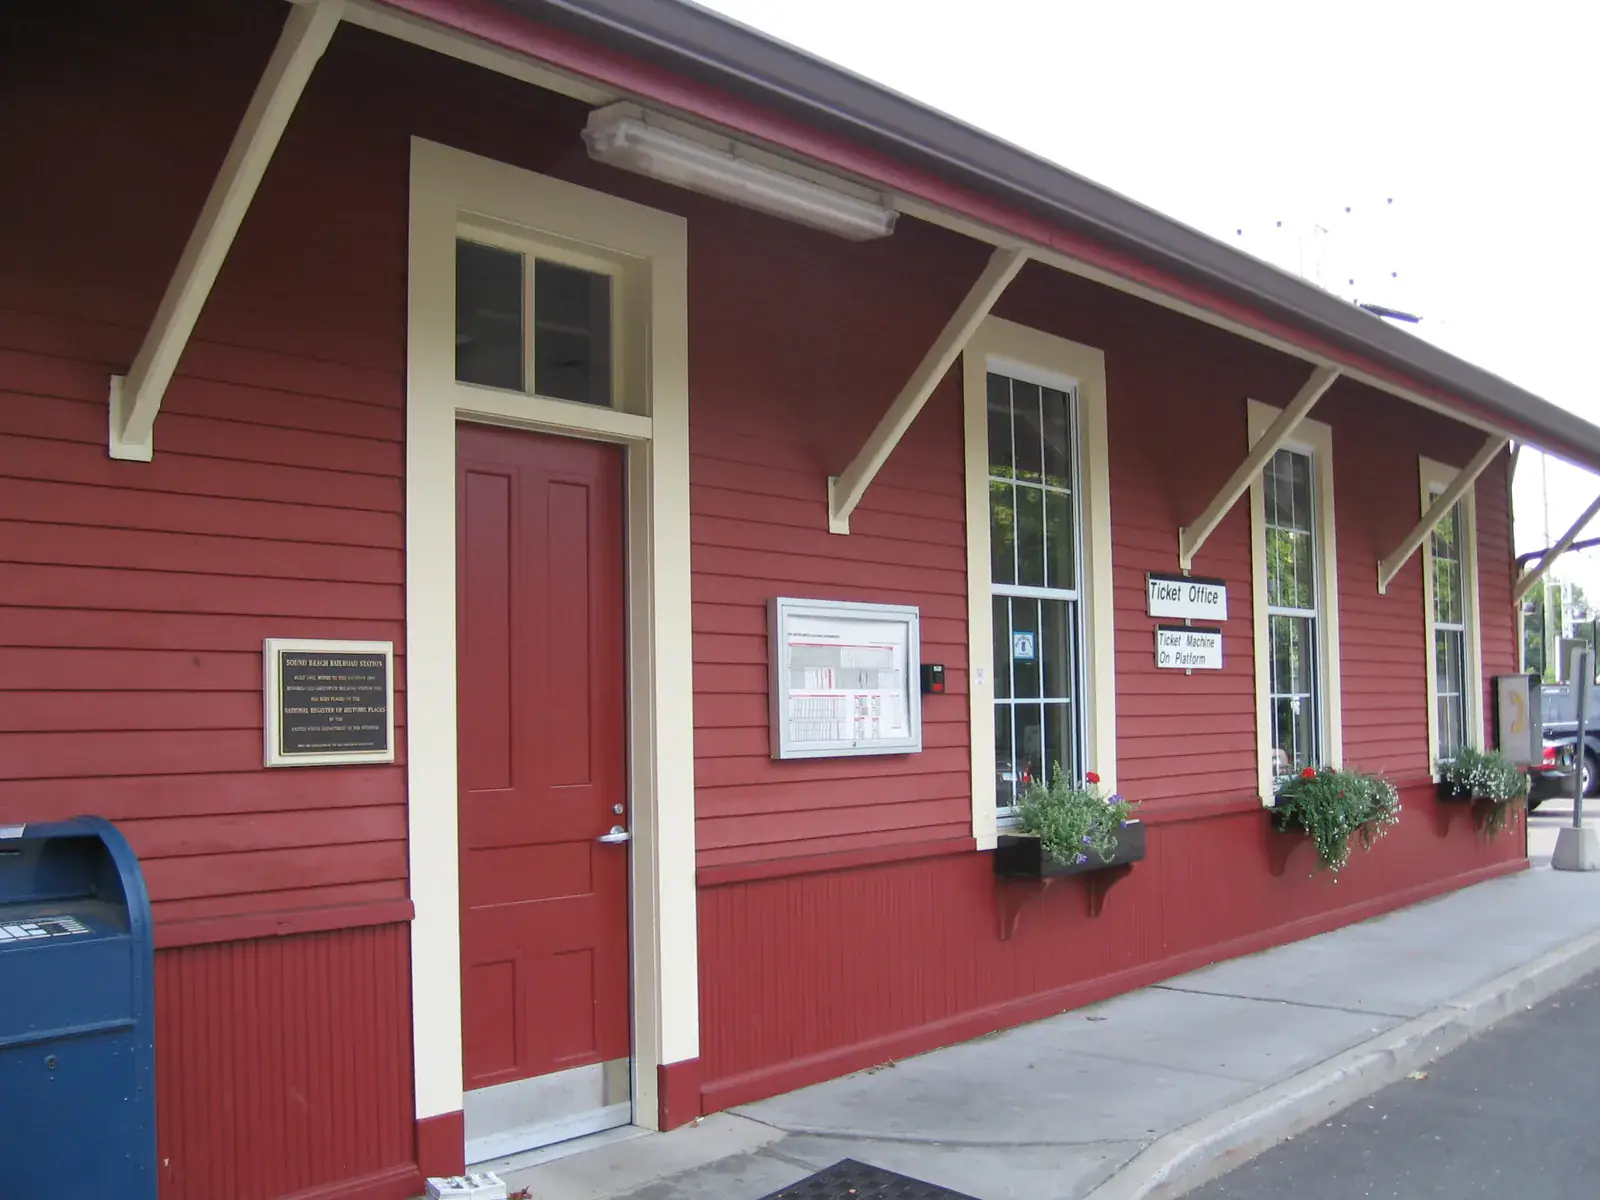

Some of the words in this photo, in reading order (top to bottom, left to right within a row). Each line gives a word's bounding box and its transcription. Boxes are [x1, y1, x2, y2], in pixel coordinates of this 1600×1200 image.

[1150, 582, 1181, 602] Ticket
[1189, 585, 1219, 604] Office
[1159, 633, 1182, 646] Ticket
[1186, 634, 1215, 648] Machine
[286, 659, 307, 667] SOUND
[359, 660, 383, 668] STATION
[1159, 651, 1170, 664] On
[1175, 652, 1206, 665] Platform
